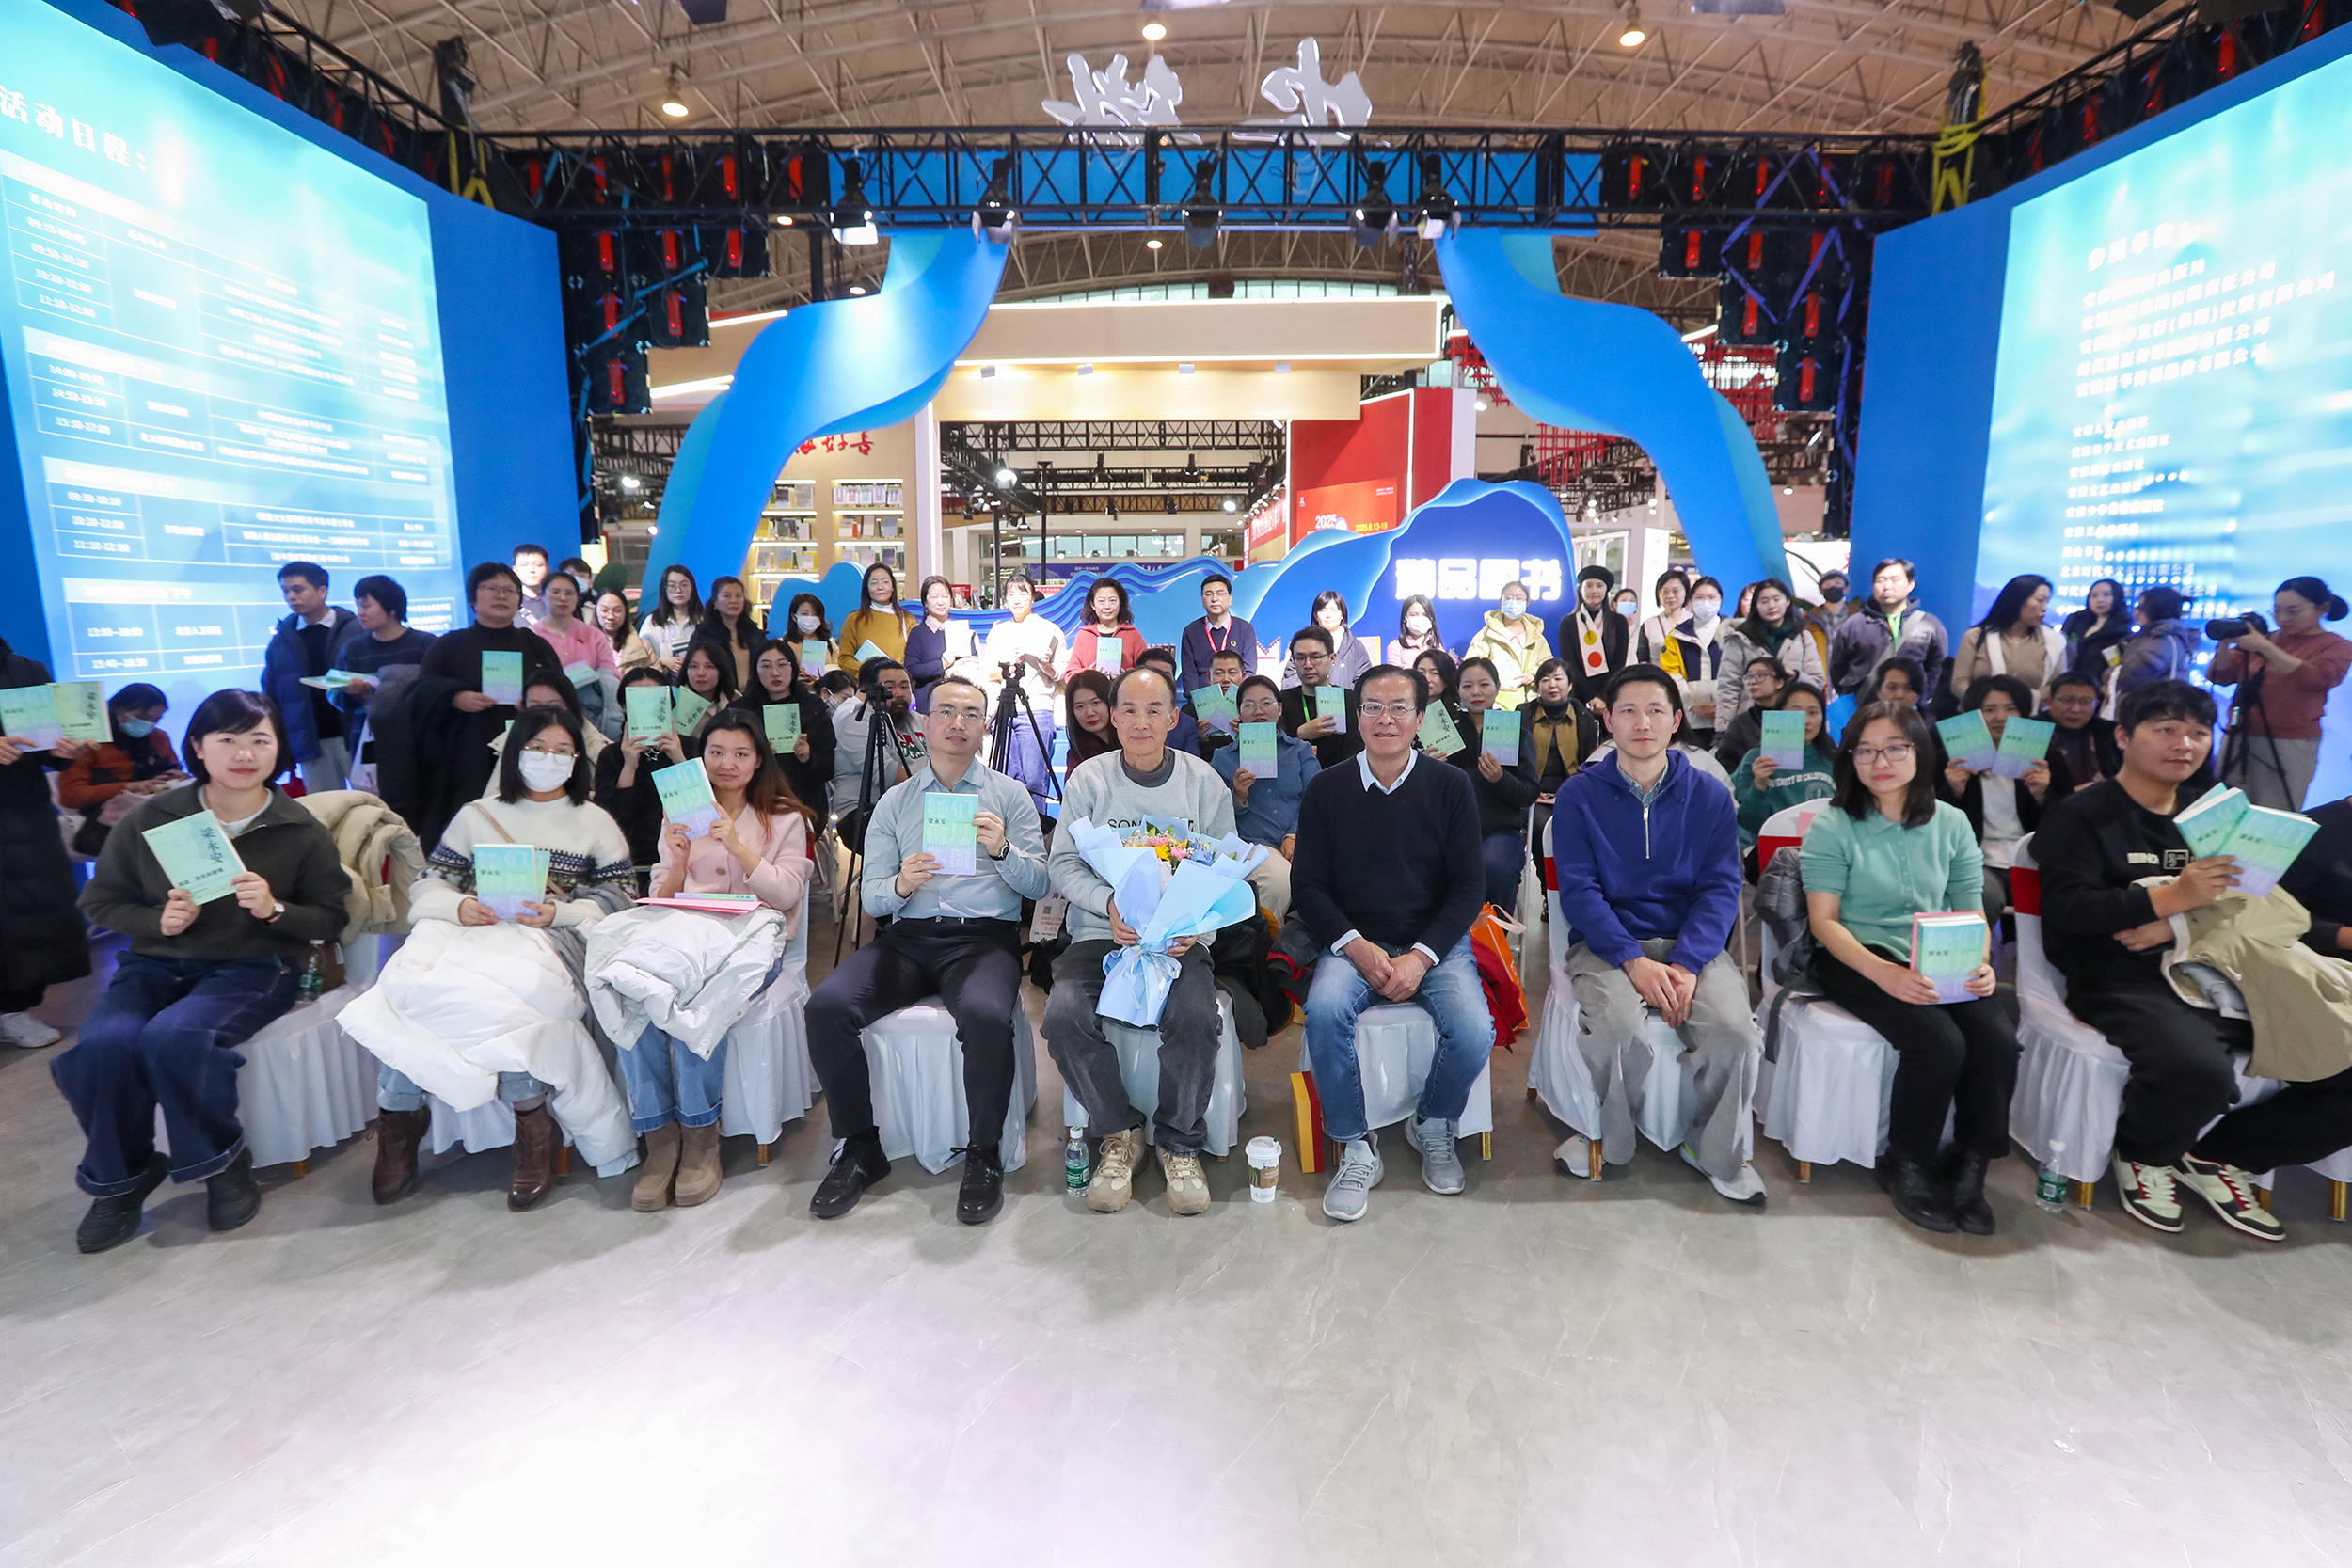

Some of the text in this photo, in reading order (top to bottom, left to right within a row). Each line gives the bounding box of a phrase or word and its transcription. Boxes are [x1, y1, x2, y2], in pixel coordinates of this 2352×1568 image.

[0, 85, 147, 171] 活动日程：
[1395, 558, 1563, 601] 精品图书
[200, 827, 224, 864] 梁永安
